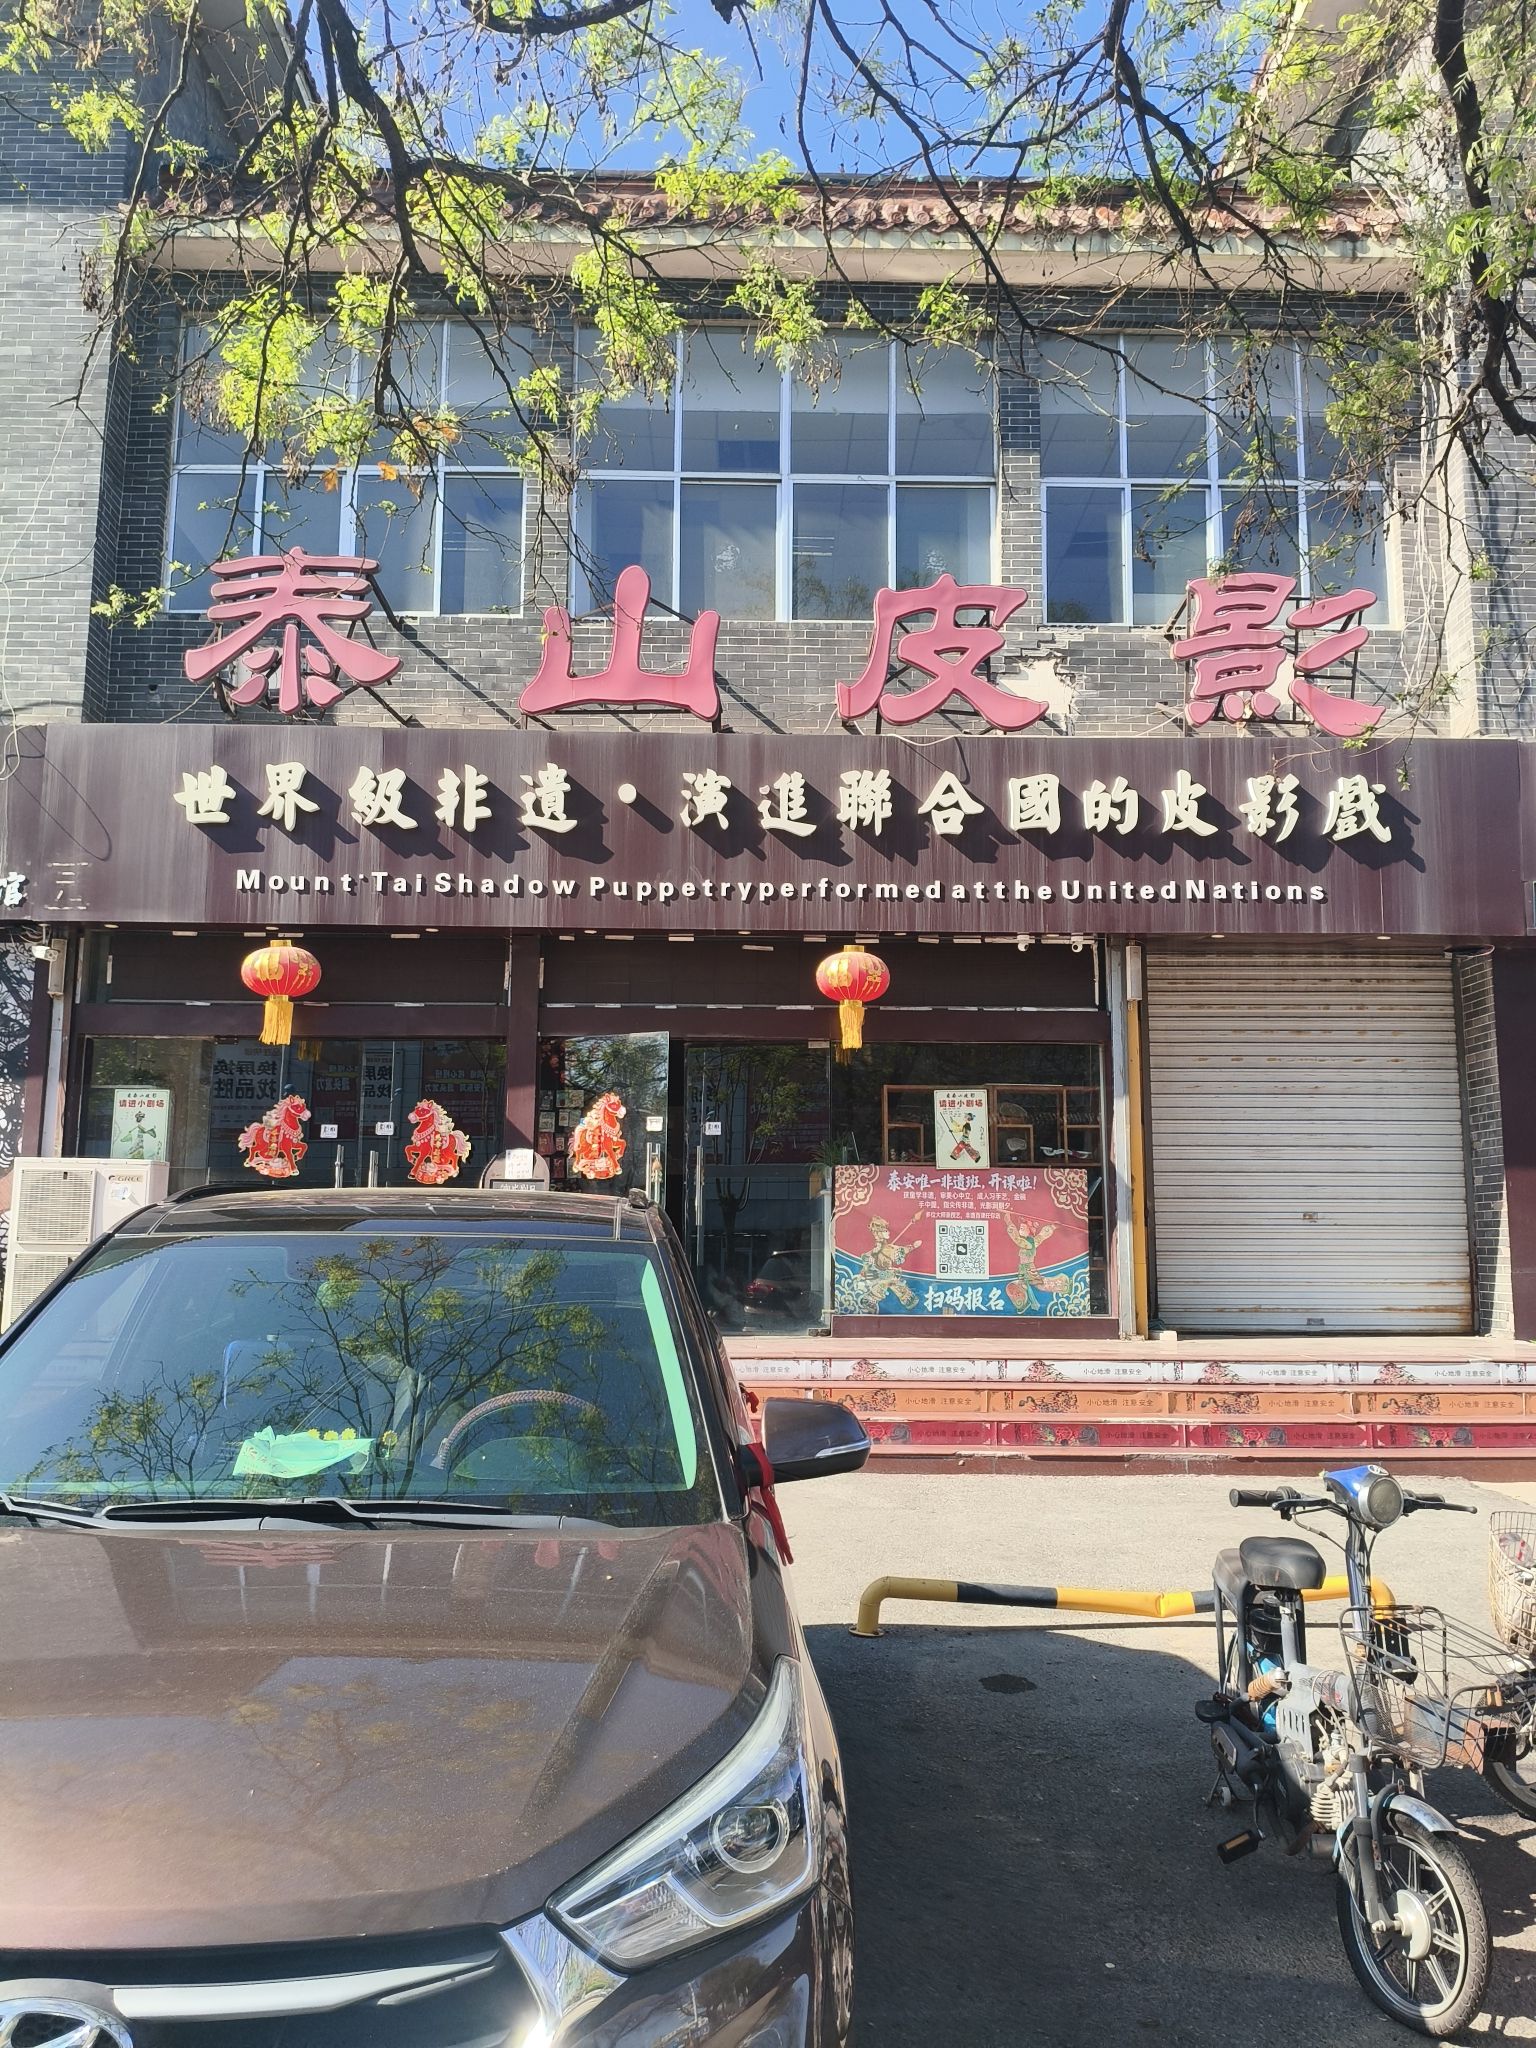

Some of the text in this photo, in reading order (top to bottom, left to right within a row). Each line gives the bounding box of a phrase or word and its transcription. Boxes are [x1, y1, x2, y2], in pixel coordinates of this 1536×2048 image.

[184, 546, 1387, 738] 泰山皮影
[923, 1285, 1005, 1312] 扫码报名
[907, 1366, 966, 1374] 小心地滑 注意安全
[1259, 1369, 1318, 1377] 小心地滑 注意安全
[905, 1397, 972, 1405] 小心地滑 注意安全
[1087, 1398, 1153, 1406] 小心地滑 注意安全
